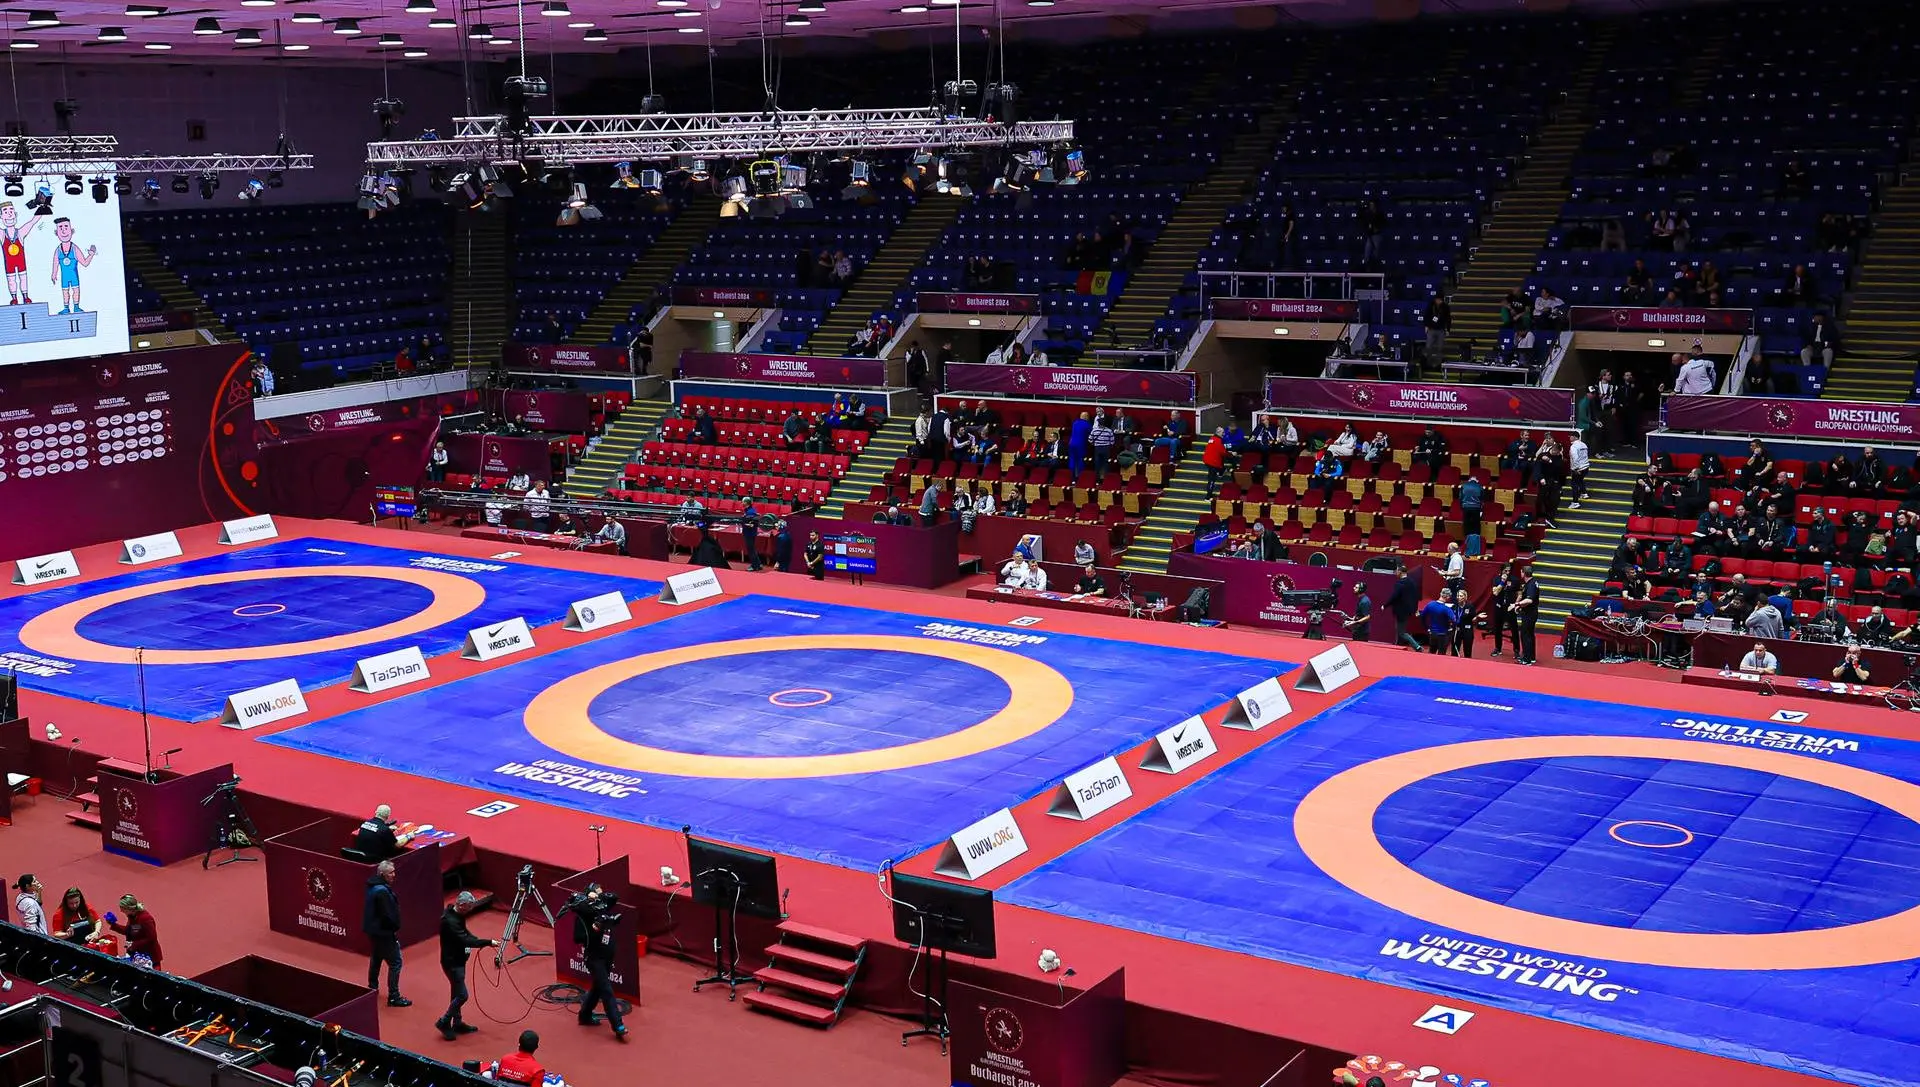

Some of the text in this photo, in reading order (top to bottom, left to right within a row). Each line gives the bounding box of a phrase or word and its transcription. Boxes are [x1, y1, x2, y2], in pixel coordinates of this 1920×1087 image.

[713, 291, 750, 300] Bucharest 2024
[966, 297, 1010, 307] Bucharest 2024
[1271, 302, 1323, 313] Bucharest 2024
[1642, 312, 1706, 324] Bucharest 2024
[556, 351, 590, 361] WRESTLING
[132, 362, 162, 373] WRESTLING
[769, 360, 808, 372] WRESTLING
[1052, 372, 1099, 385] WRESTLING
[1044, 383, 1107, 393] EUROPEAN CHAMPIONSHIPS
[1400, 388, 1457, 402] WRESTLING
[1390, 400, 1468, 411] EUROPEAN CHAMPIONSHIPS
[339, 408, 375, 422] WRESTLING
[1828, 408, 1900, 424] WRESTLING
[1815, 421, 1913, 434] EUROPEAN CHAMPIONSHIPS
[34, 567, 67, 581] WRESTLING
[1260, 611, 1307, 624] Bucharest 2024
[918, 622, 1048, 645] WRESTLING
[488, 634, 521, 651] WRESTLING
[370, 661, 421, 684] TaiShan
[244, 694, 296, 718] UWW.ORG
[1673, 719, 1859, 752] WRESTLING
[1684, 729, 1834, 755] UNITED WORLD
[1176, 738, 1204, 760] WRESTLING
[494, 762, 640, 798] WRESTLING
[531, 759, 643, 785] UNITED WORLD
[1077, 773, 1121, 804] TaiShan
[112, 830, 136, 846] Bucharest
[137, 838, 149, 849] 2024
[967, 826, 1014, 860] UWW.ORG
[308, 903, 334, 916] WRESTLING
[299, 914, 329, 932] Bucharest
[331, 924, 346, 936] 2024
[1418, 933, 1608, 979] UNITED WORLD
[608, 972, 623, 985] 024
[1422, 1012, 1455, 1029] A
[986, 1051, 1024, 1069] WRESTLING
[970, 1063, 1016, 1087] Bucharest
